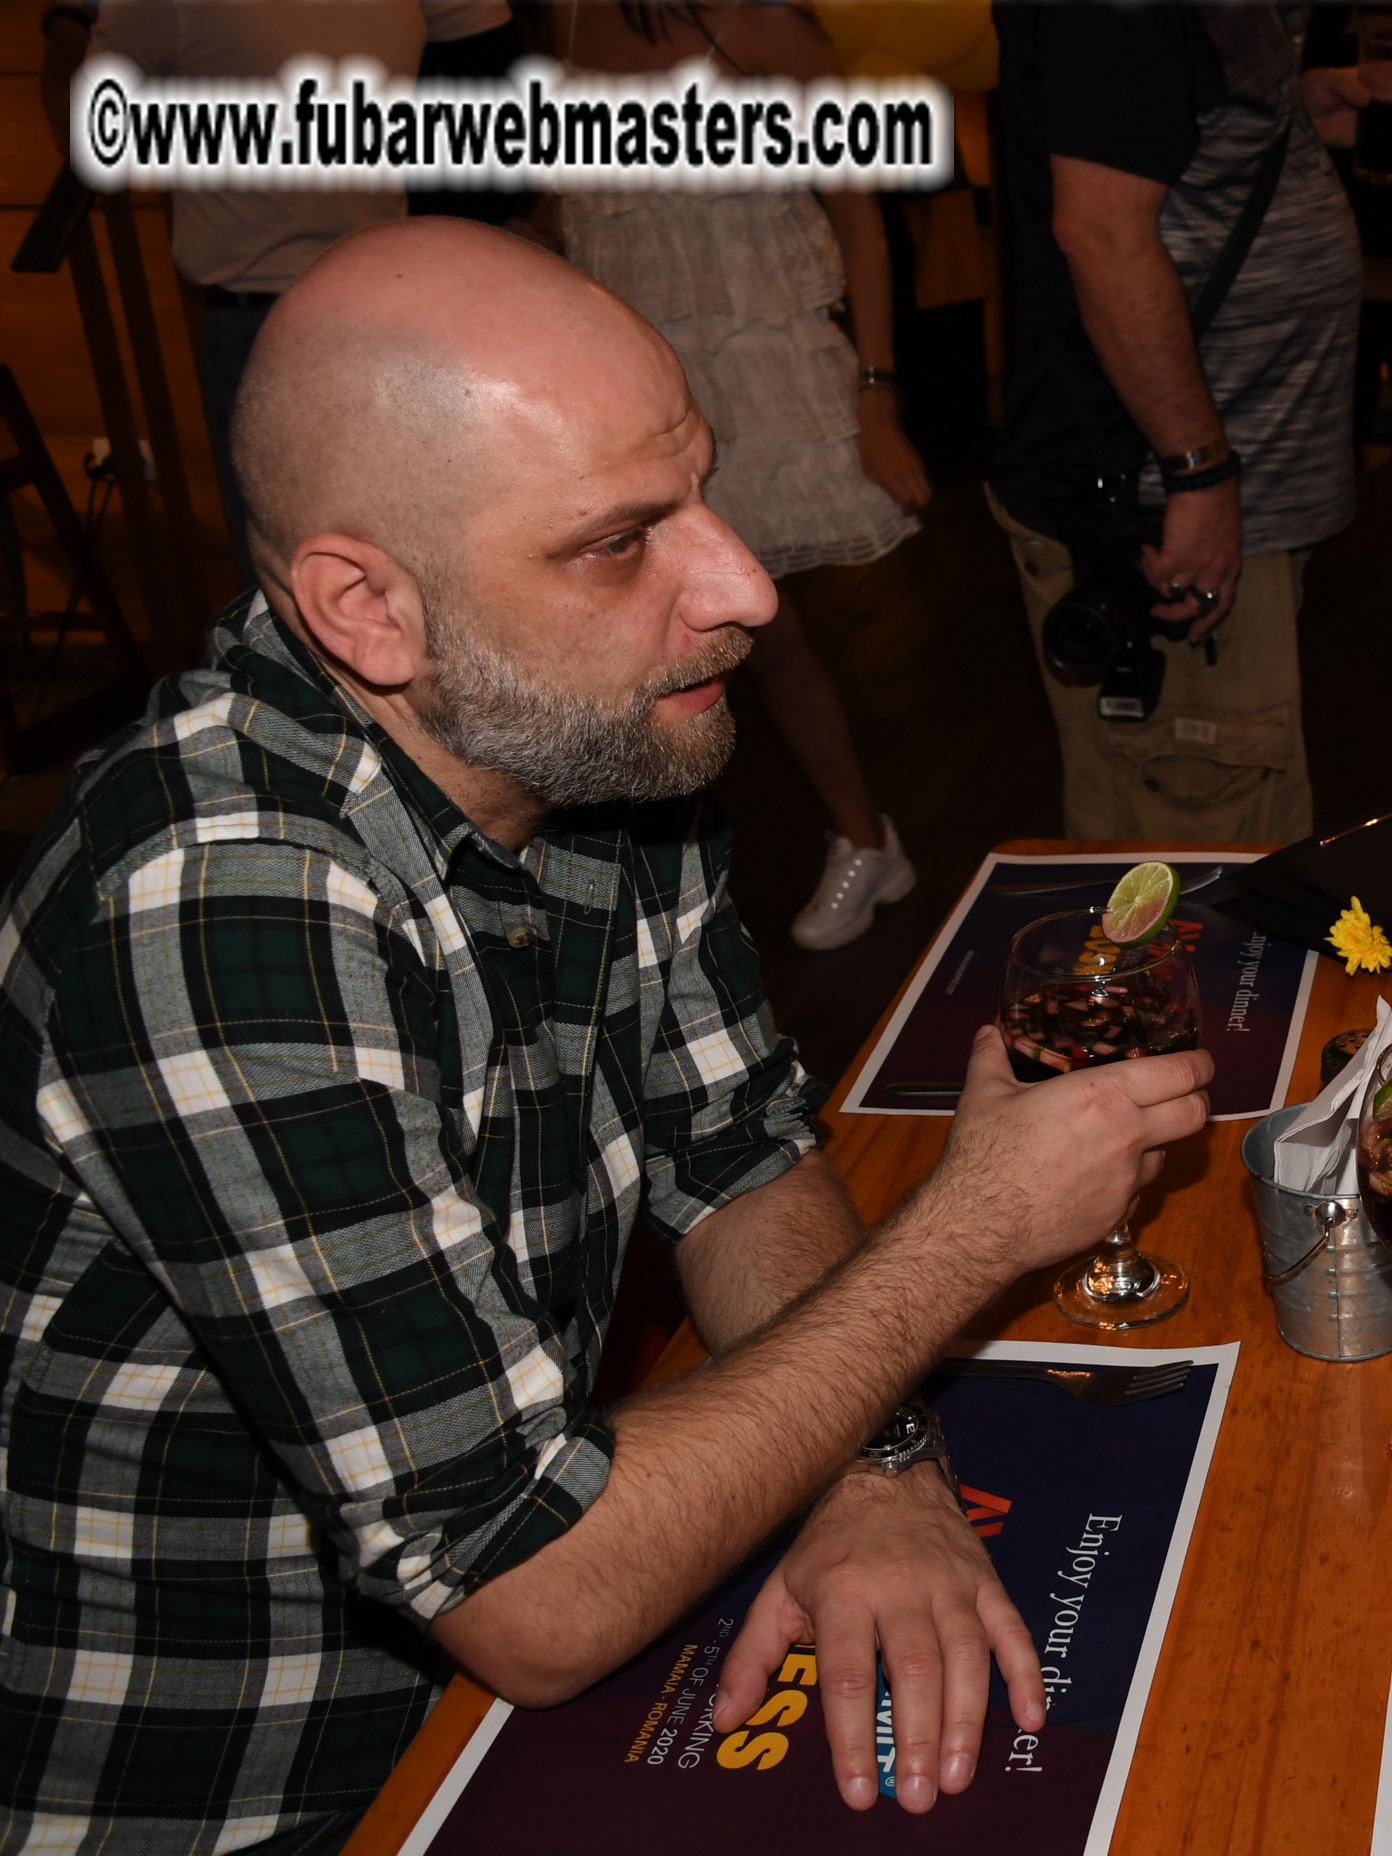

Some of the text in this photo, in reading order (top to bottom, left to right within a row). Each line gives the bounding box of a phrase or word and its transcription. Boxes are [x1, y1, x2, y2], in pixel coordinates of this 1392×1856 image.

[1226, 931, 1272, 1032] njoy your dinner!
[1056, 1513, 1123, 1589] Enjoy
[1043, 1592, 1086, 1659] your
[660, 1643, 699, 1694] MAMAIA
[689, 1666, 708, 1687] OF
[624, 1701, 668, 1764] ROMANIA
[666, 1688, 697, 1725] JUNE
[647, 1728, 678, 1766] 2020
